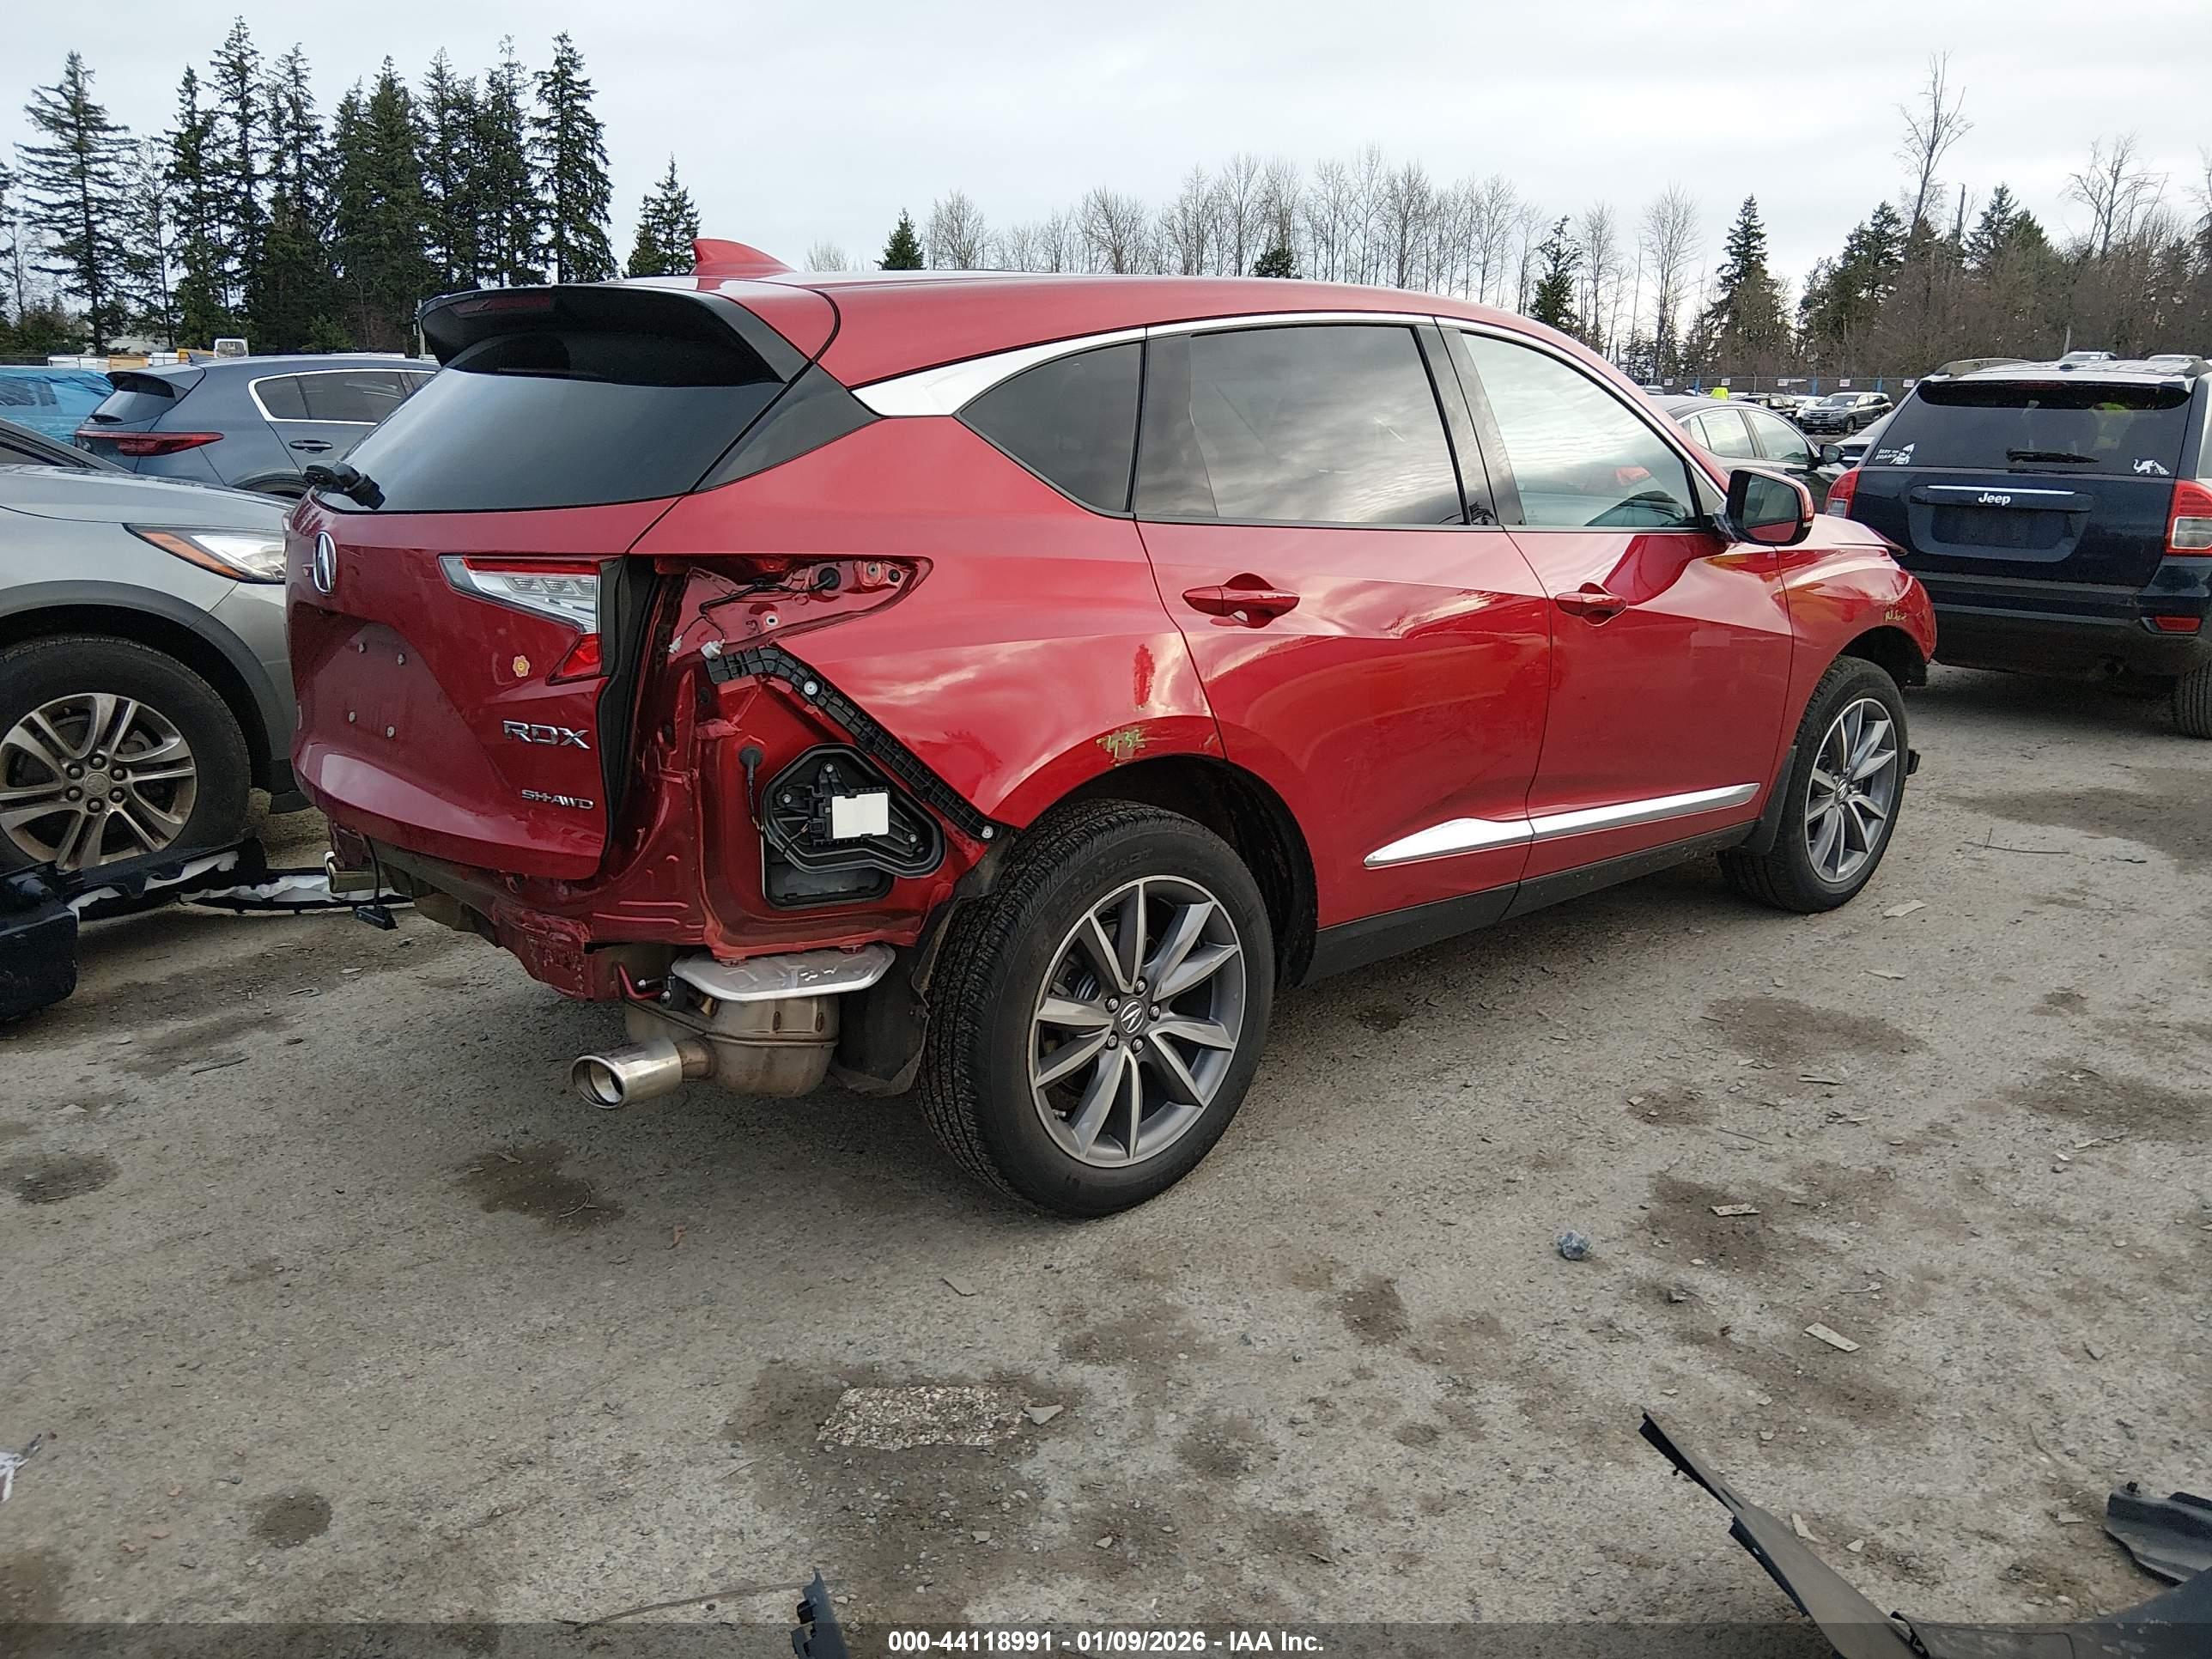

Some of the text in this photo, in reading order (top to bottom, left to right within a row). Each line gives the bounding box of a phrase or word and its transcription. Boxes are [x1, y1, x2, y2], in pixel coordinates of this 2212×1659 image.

[1978, 492, 2011, 506] Jeep
[502, 720, 591, 750] RDX
[521, 789, 594, 810] SH-AWD
